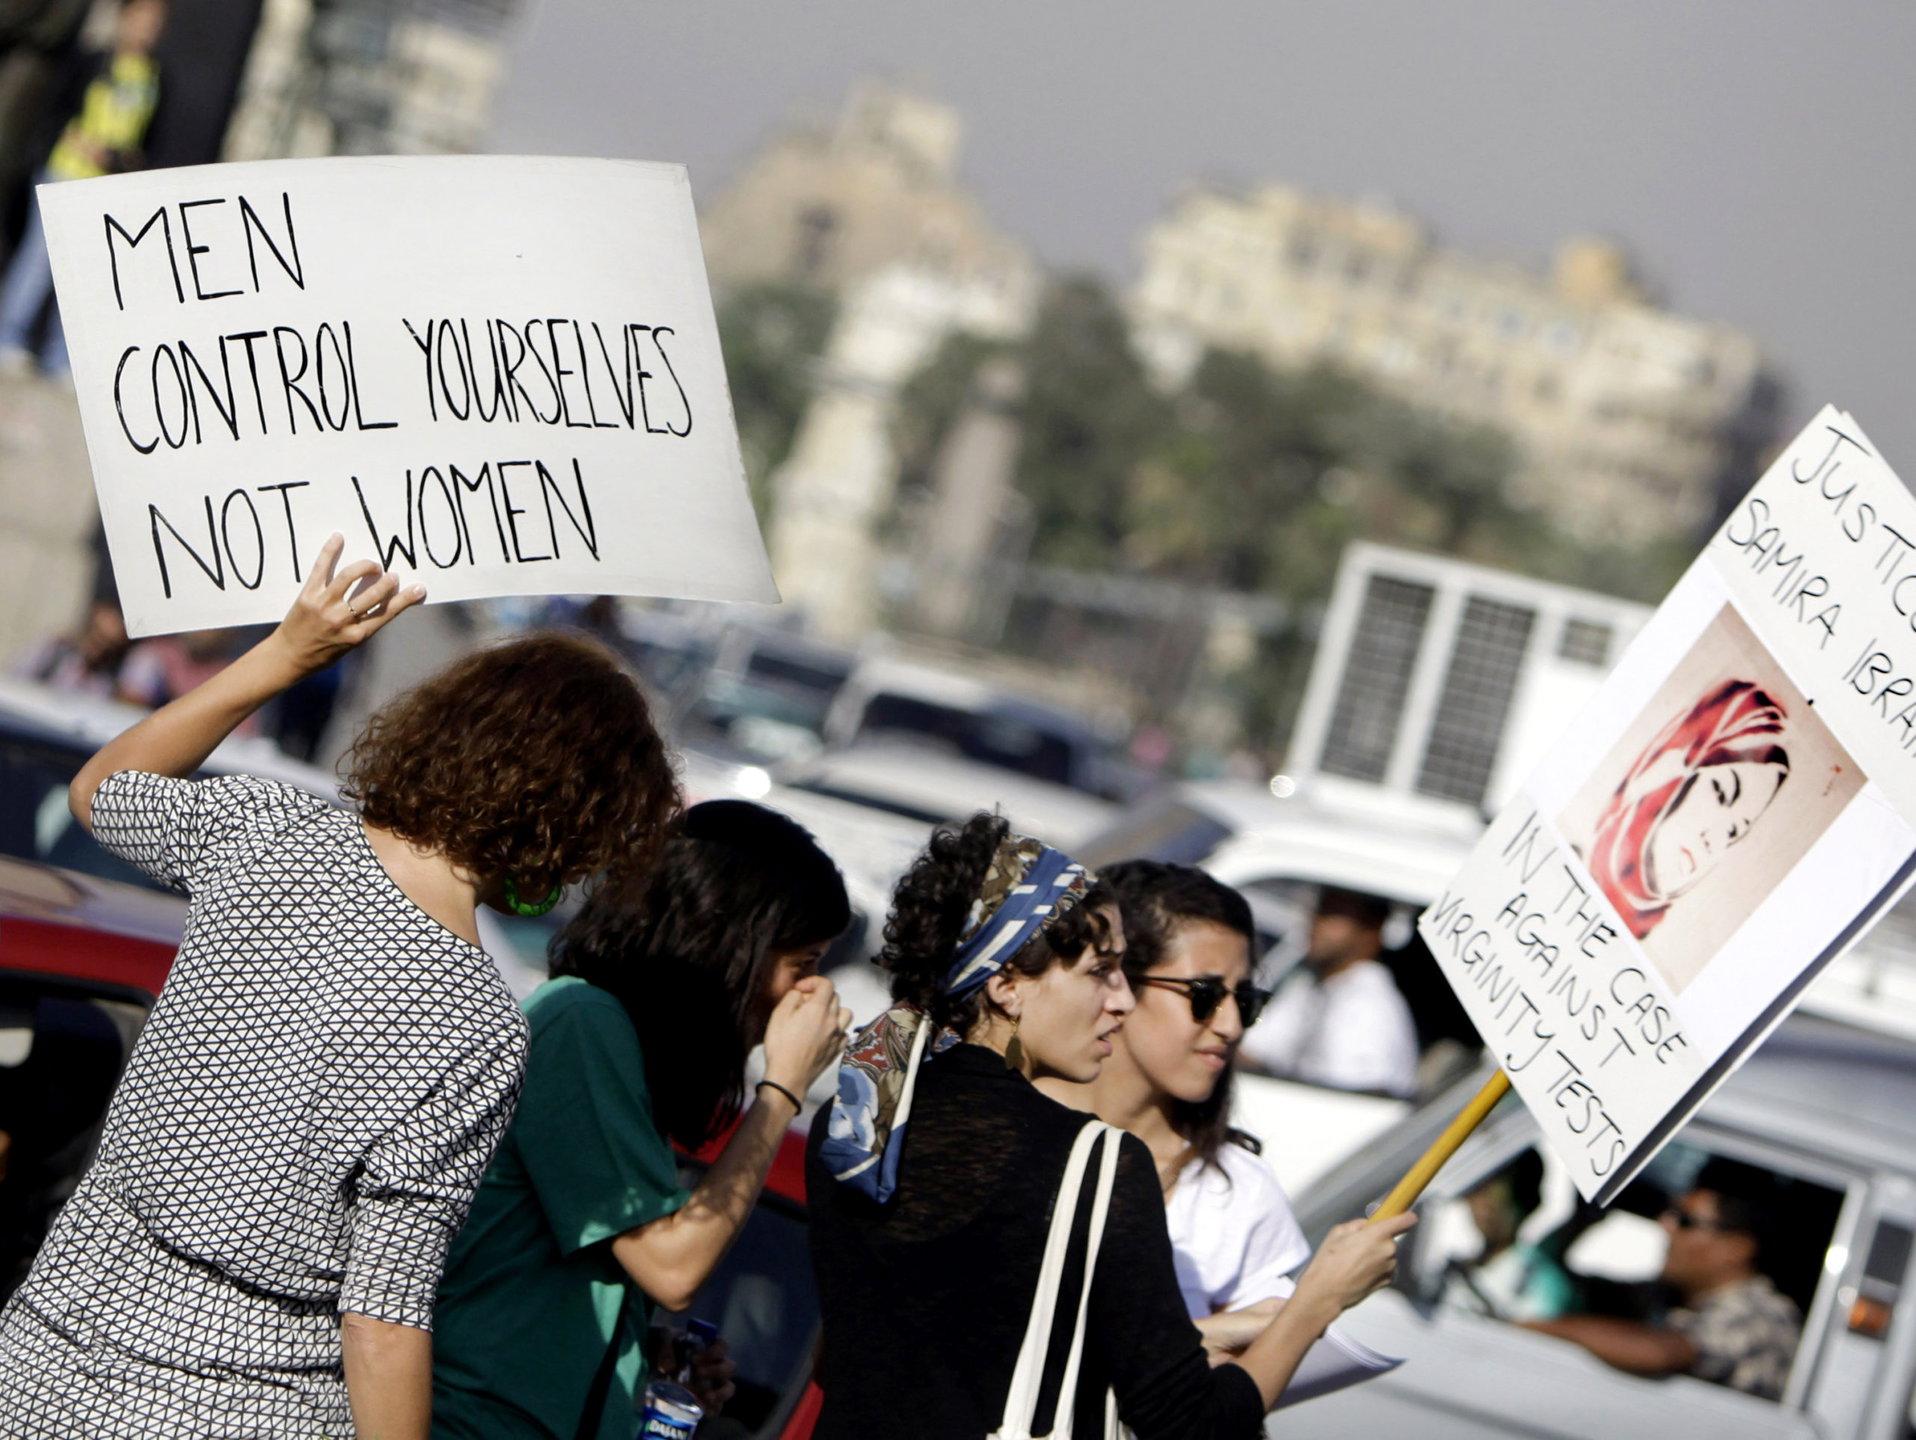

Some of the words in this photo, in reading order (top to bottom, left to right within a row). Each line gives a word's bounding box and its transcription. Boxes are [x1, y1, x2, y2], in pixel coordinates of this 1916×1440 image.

[103, 191, 305, 311] MEN
[114, 320, 399, 455] CONTROL
[402, 317, 693, 438] YOURSELVES
[148, 481, 310, 599] NOT
[351, 457, 601, 572] WOMEN
[1792, 425, 1916, 634] JUSTIC
[1727, 498, 1842, 650] SAMIRA
[1842, 638, 1916, 758] IBRA
[1496, 892, 1636, 1068] AGAINST
[1502, 810, 1557, 885] IN
[1553, 864, 1618, 959] THE
[1610, 967, 1688, 1064] CASE
[1432, 891, 1556, 1072] VIRGINITY
[1546, 1049, 1626, 1176] TESTS
